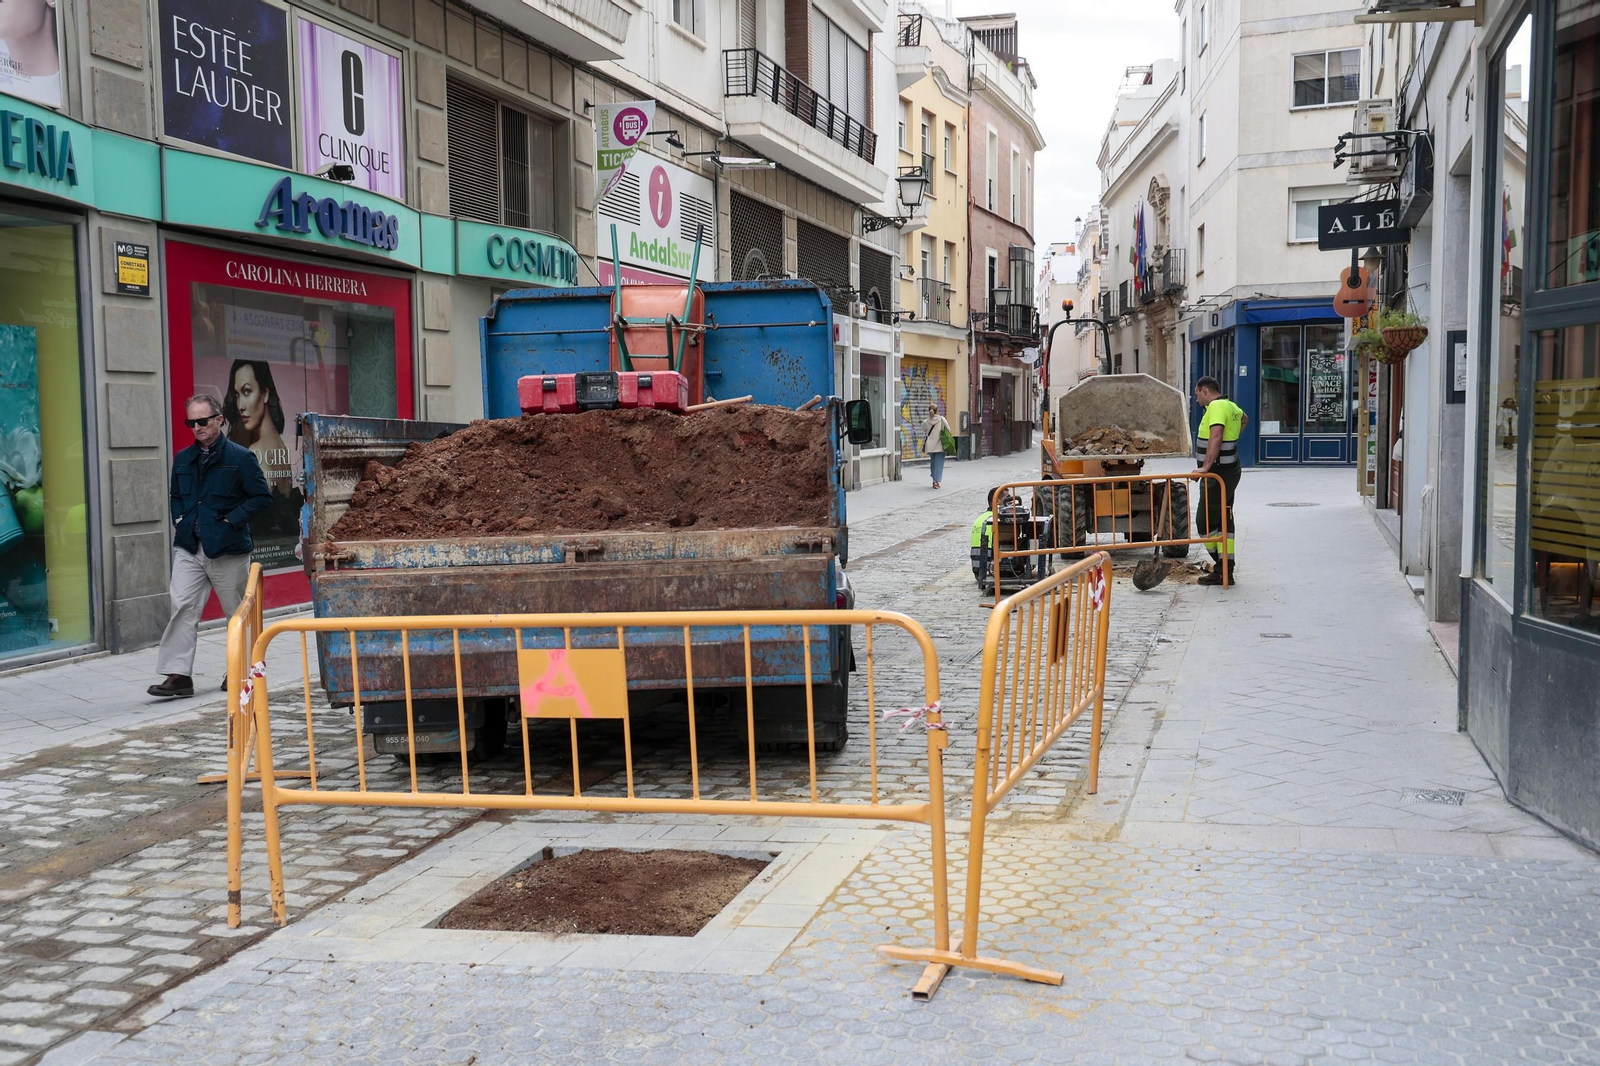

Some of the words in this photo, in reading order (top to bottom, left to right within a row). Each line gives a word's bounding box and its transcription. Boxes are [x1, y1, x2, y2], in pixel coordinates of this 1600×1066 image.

[175, 58, 283, 126] LAUDER
[600, 108, 610, 149] AUTOBUS
[625, 121, 638, 129] BUS
[0, 109, 79, 187] ERIA
[318, 132, 390, 175] CLINIQUE
[254, 176, 399, 251] Aromas
[1328, 209, 1395, 234] ALÉ
[629, 231, 692, 271] AndalSur
[225, 260, 302, 288] CAROLINA
[305, 272, 368, 297] HERRERA
[265, 448, 296, 466] GIRL
[520, 649, 593, 718] A
[385, 736, 399, 744] 955
[415, 735, 430, 743] 040
